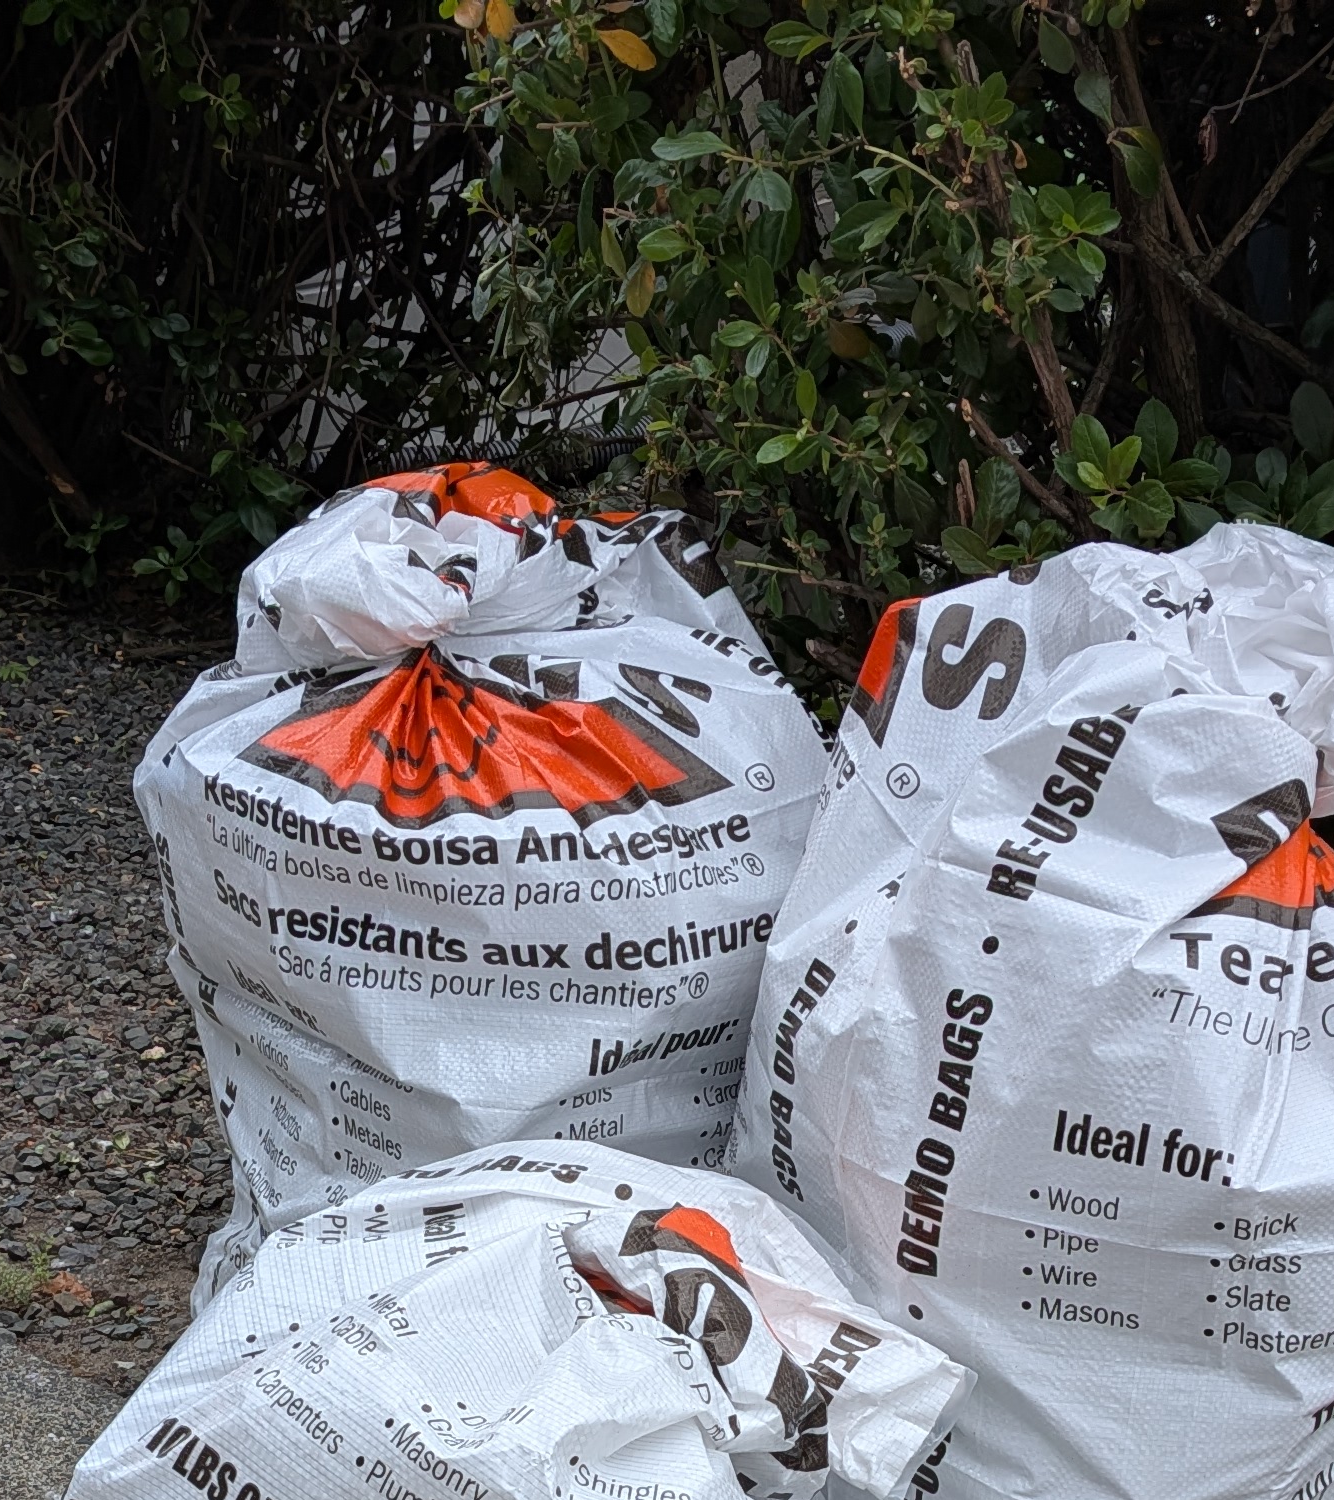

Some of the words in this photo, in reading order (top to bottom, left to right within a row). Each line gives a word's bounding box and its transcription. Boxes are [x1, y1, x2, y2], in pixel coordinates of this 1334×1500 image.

[921, 603, 1027, 721] S
[204, 773, 363, 855] Resistente
[232, 825, 277, 872] última
[284, 850, 351, 885] bolsa
[358, 867, 389, 890] de
[395, 871, 505, 906] limpieza
[515, 880, 581, 912] para
[214, 868, 262, 928] Sacs
[268, 904, 468, 964] resistants
[482, 942, 571, 970] aux
[584, 911, 780, 972] dechirure
[338, 961, 423, 993] rebuts
[429, 975, 496, 999] pour
[502, 972, 541, 1001] les
[659, 1017, 741, 1060] pour:
[773, 957, 837, 1086] DEMO
[339, 1079, 392, 1123] Cables
[343, 1113, 403, 1161] Metales
[569, 1113, 624, 1142] Métal
[769, 1088, 805, 1204] BAGS
[896, 1136, 956, 1278] DEMO
[927, 987, 995, 1133] BAGS
[1053, 1108, 1152, 1168] Ideal
[1161, 1127, 1235, 1188] for:
[246, 1158, 283, 1210] Tabiques
[1047, 1184, 1120, 1221] Wood
[1042, 1227, 1100, 1255] Pipe
[1233, 1212, 1299, 1241] Brick
[1040, 1262, 1099, 1288] Wire
[1228, 1253, 1303, 1275] Glass
[370, 1293, 419, 1338] Metal
[1039, 1296, 1140, 1330] Masons
[1224, 1284, 1292, 1313] Slate
[293, 1340, 330, 1375] Tiles
[331, 1315, 378, 1356] Cable
[255, 1369, 344, 1455] Carpenters
